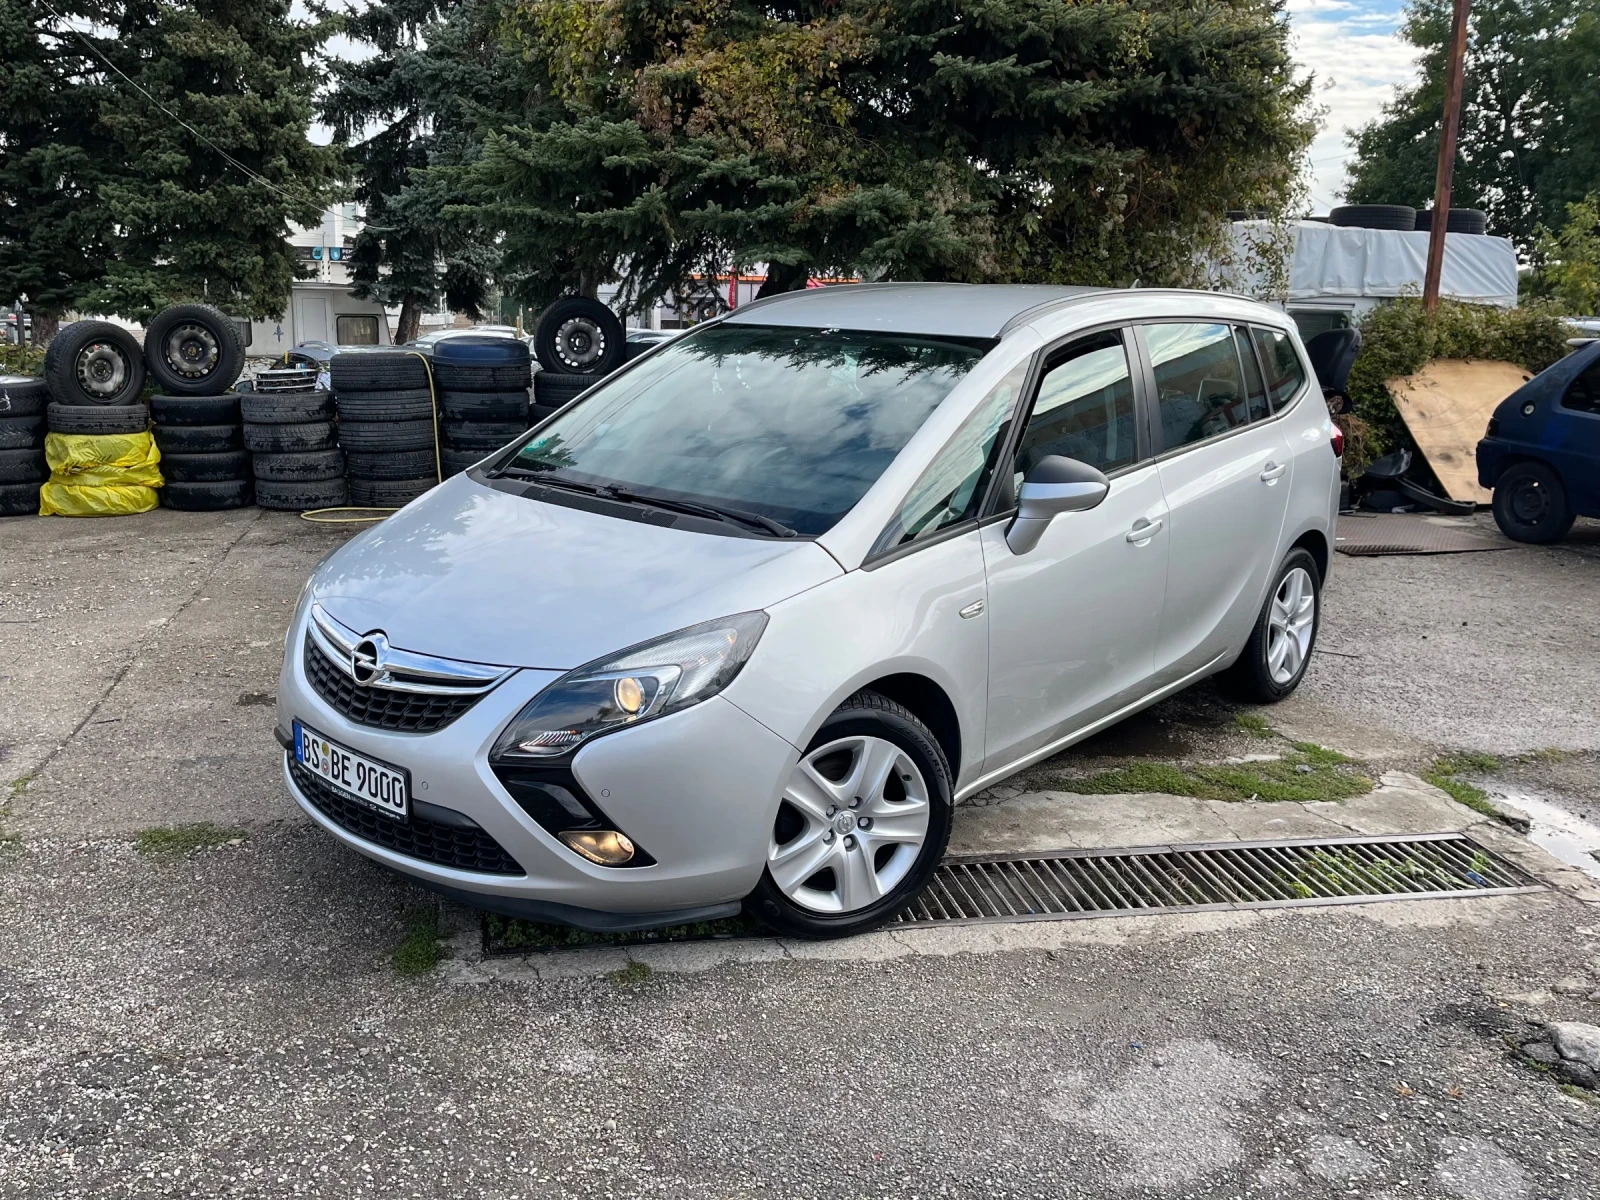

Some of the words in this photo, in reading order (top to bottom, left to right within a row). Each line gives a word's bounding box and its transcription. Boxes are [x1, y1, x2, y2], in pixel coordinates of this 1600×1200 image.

[303, 732, 320, 769] BS
[331, 748, 351, 787] BE
[356, 761, 404, 809] 9000
